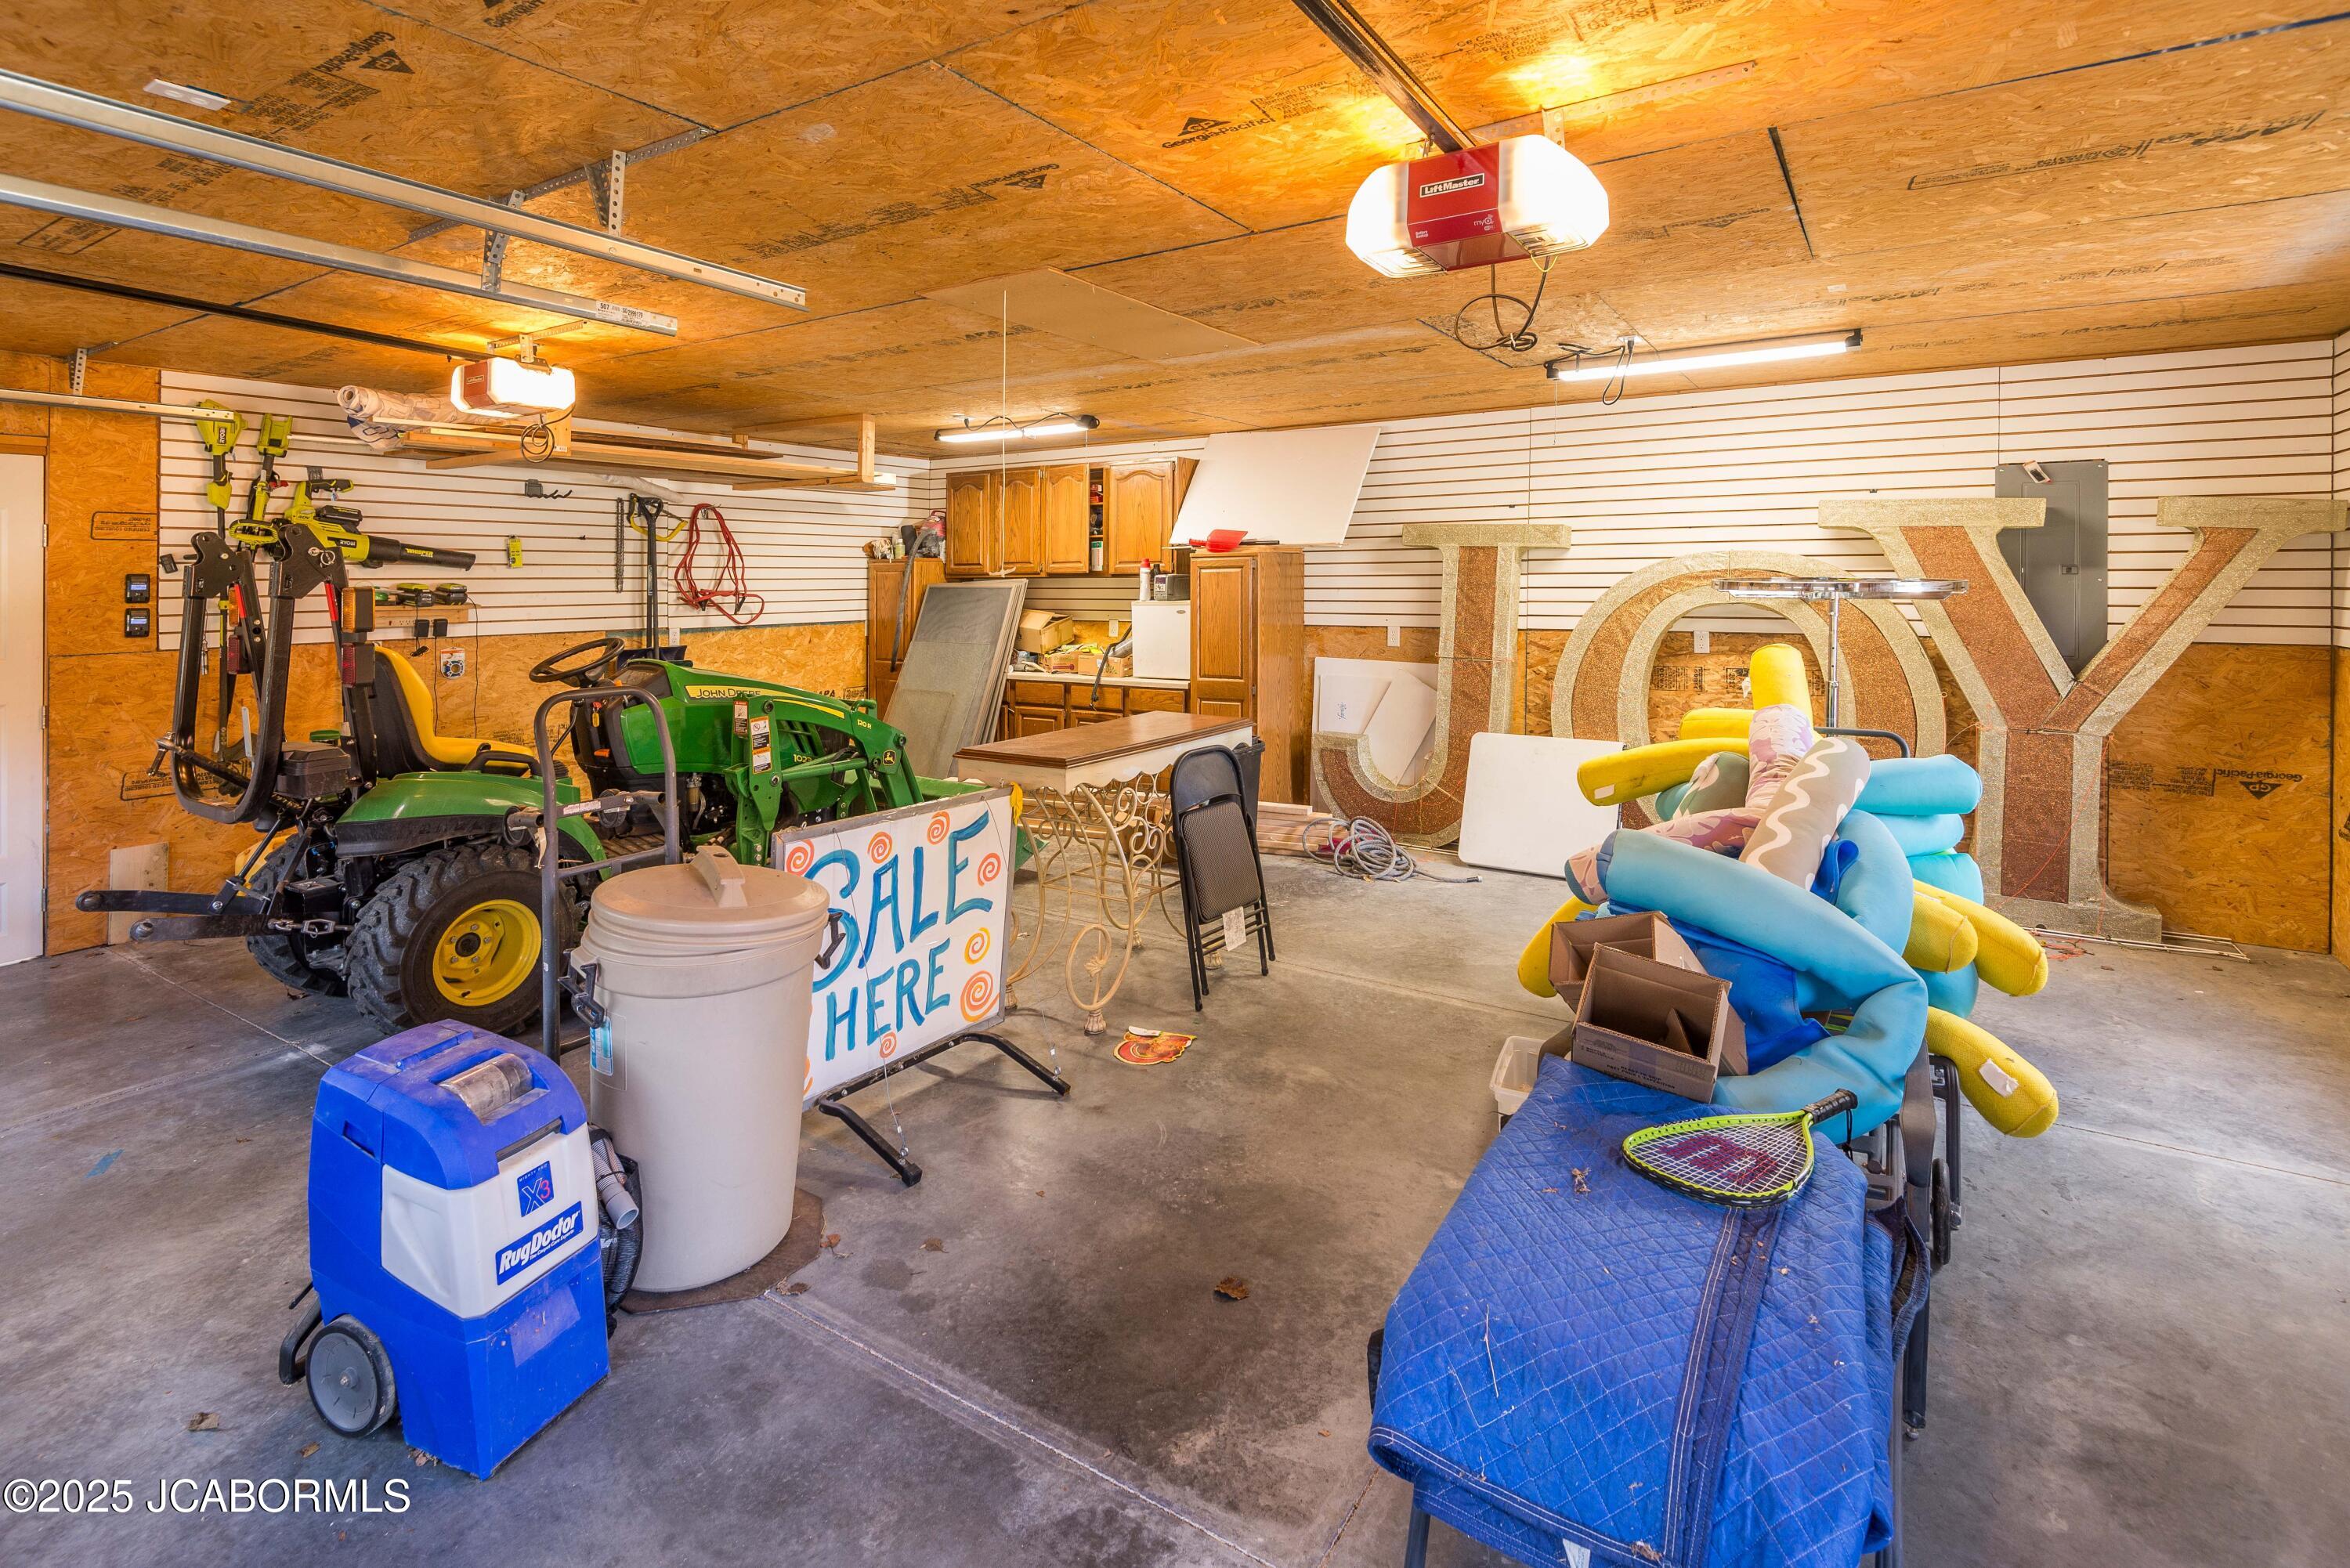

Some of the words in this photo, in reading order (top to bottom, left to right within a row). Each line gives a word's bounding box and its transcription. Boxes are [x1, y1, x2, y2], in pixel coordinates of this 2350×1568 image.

[1162, 118, 1271, 148] Georgia-Pacific
[1424, 179, 1479, 194] LiftMaster
[405, 547, 434, 556] WHISPER
[696, 688, 725, 697] JOHN
[2216, 768, 2303, 782] Georgia-Pacific
[804, 810, 992, 992] SALE
[825, 938, 951, 1062] HERE
[519, 1169, 537, 1183] MIGHTY
[537, 1164, 547, 1173] PRO
[522, 1177, 551, 1215] X3
[498, 1211, 579, 1275] RugDoctor
[550, 1238, 560, 1247] Care
